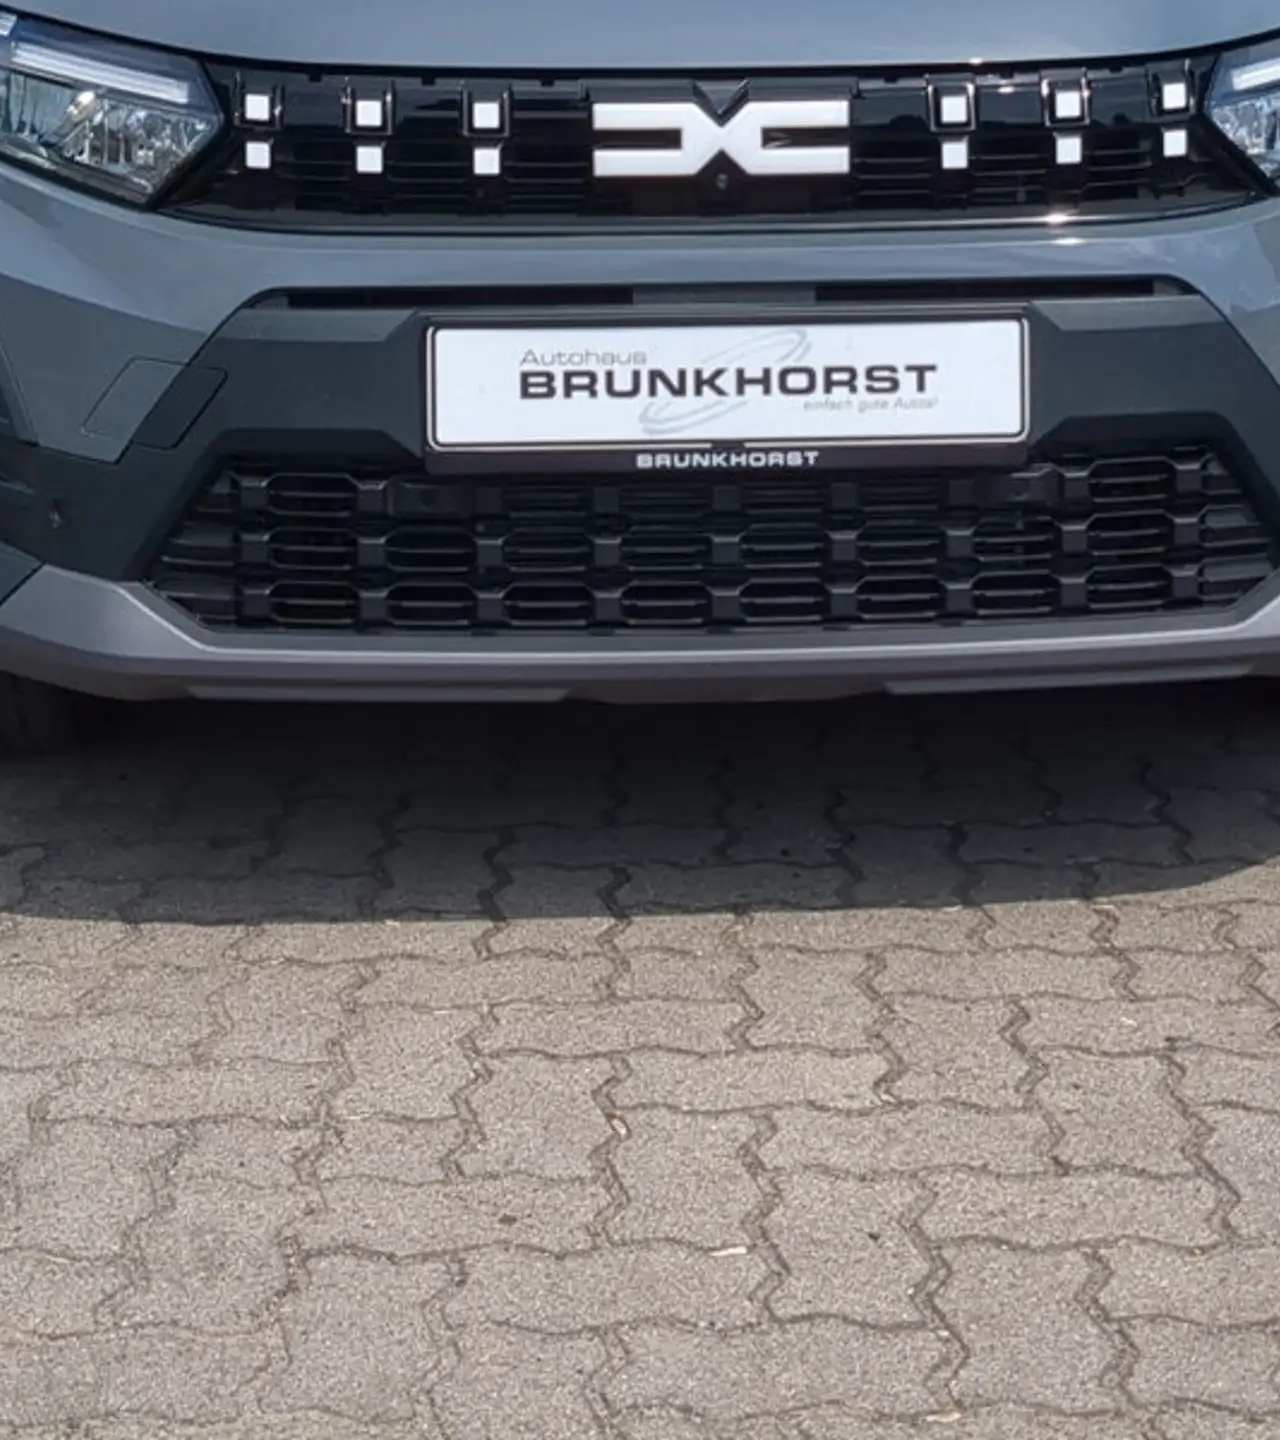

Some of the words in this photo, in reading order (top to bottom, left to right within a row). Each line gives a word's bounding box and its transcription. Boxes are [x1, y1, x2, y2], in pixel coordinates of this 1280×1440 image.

[520, 348, 647, 366] Autohaus
[519, 364, 937, 400] BRUNKHORST
[636, 451, 819, 469] BRUNKHORST
